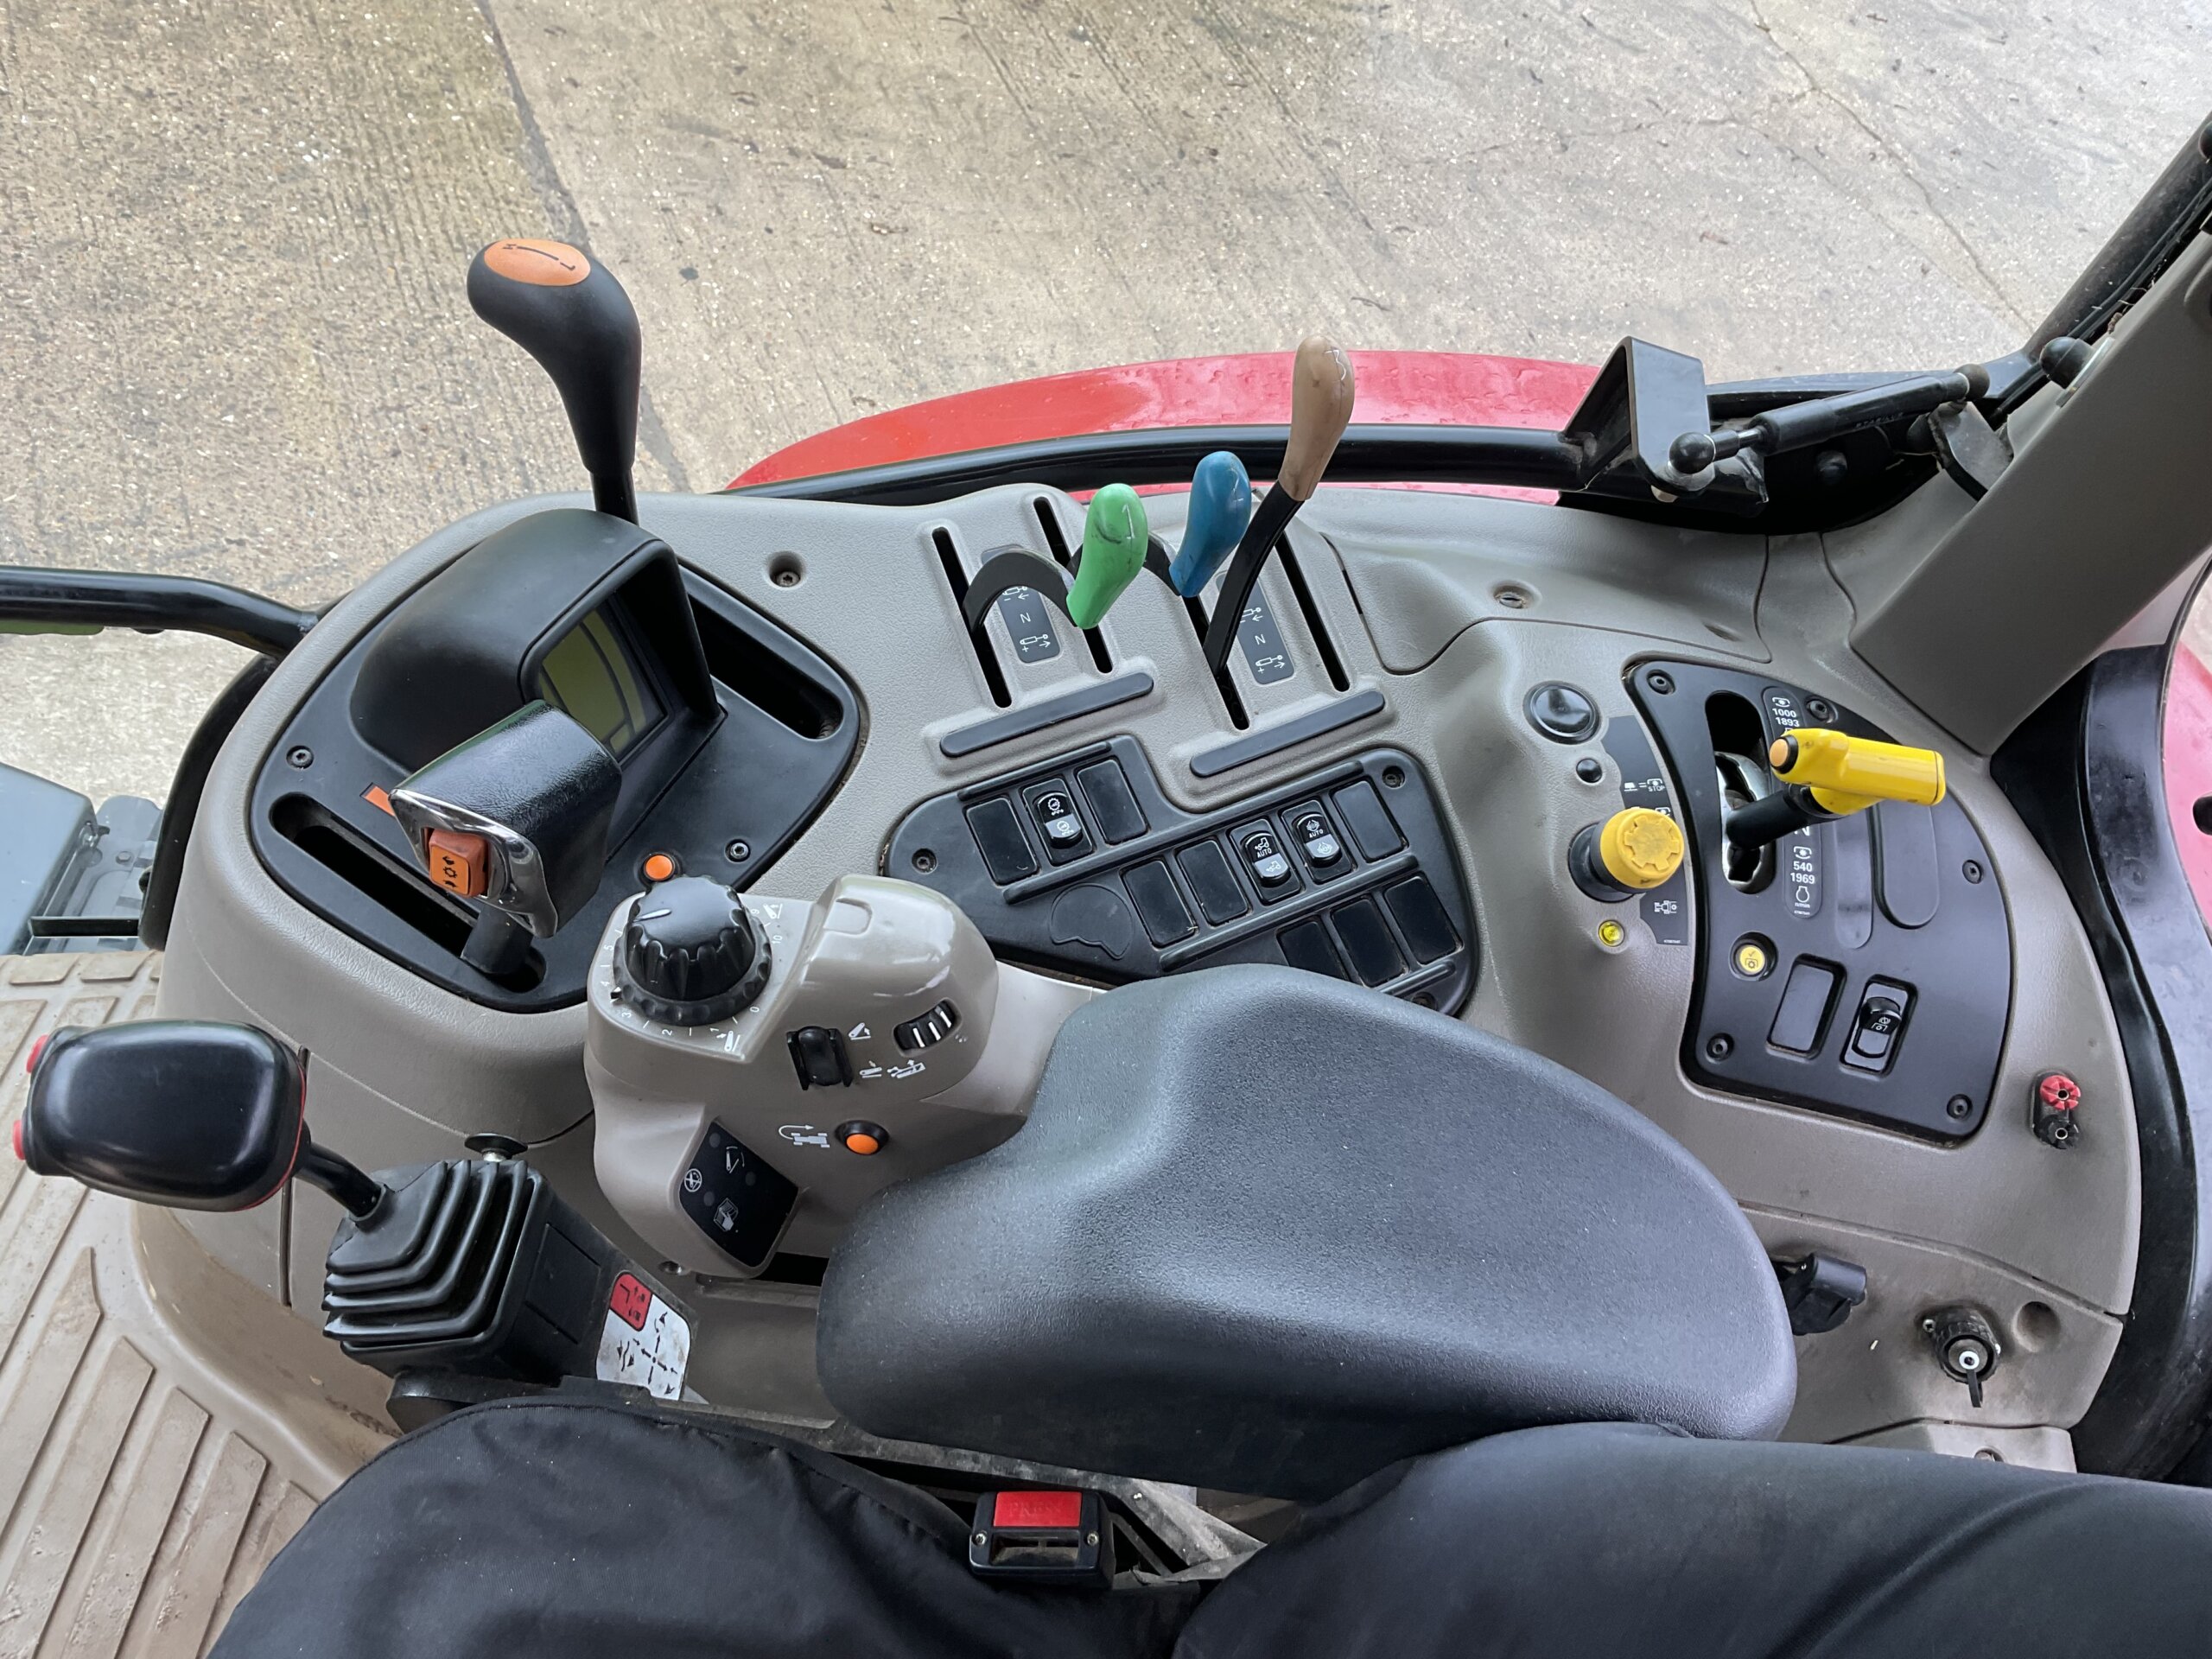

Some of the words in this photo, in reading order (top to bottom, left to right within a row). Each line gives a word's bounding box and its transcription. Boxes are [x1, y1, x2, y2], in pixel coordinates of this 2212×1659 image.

[1020, 612, 1032, 624] N
[1254, 633, 1267, 645] N
[1772, 708, 1797, 718] 1000
[1775, 716, 1800, 728] 1893
[1308, 829, 1325, 839] AUTO
[1256, 847, 1273, 859] AUTO
[1793, 861, 1813, 873] 540
[1789, 872, 1815, 885] 1969
[771, 935, 783, 944] 10
